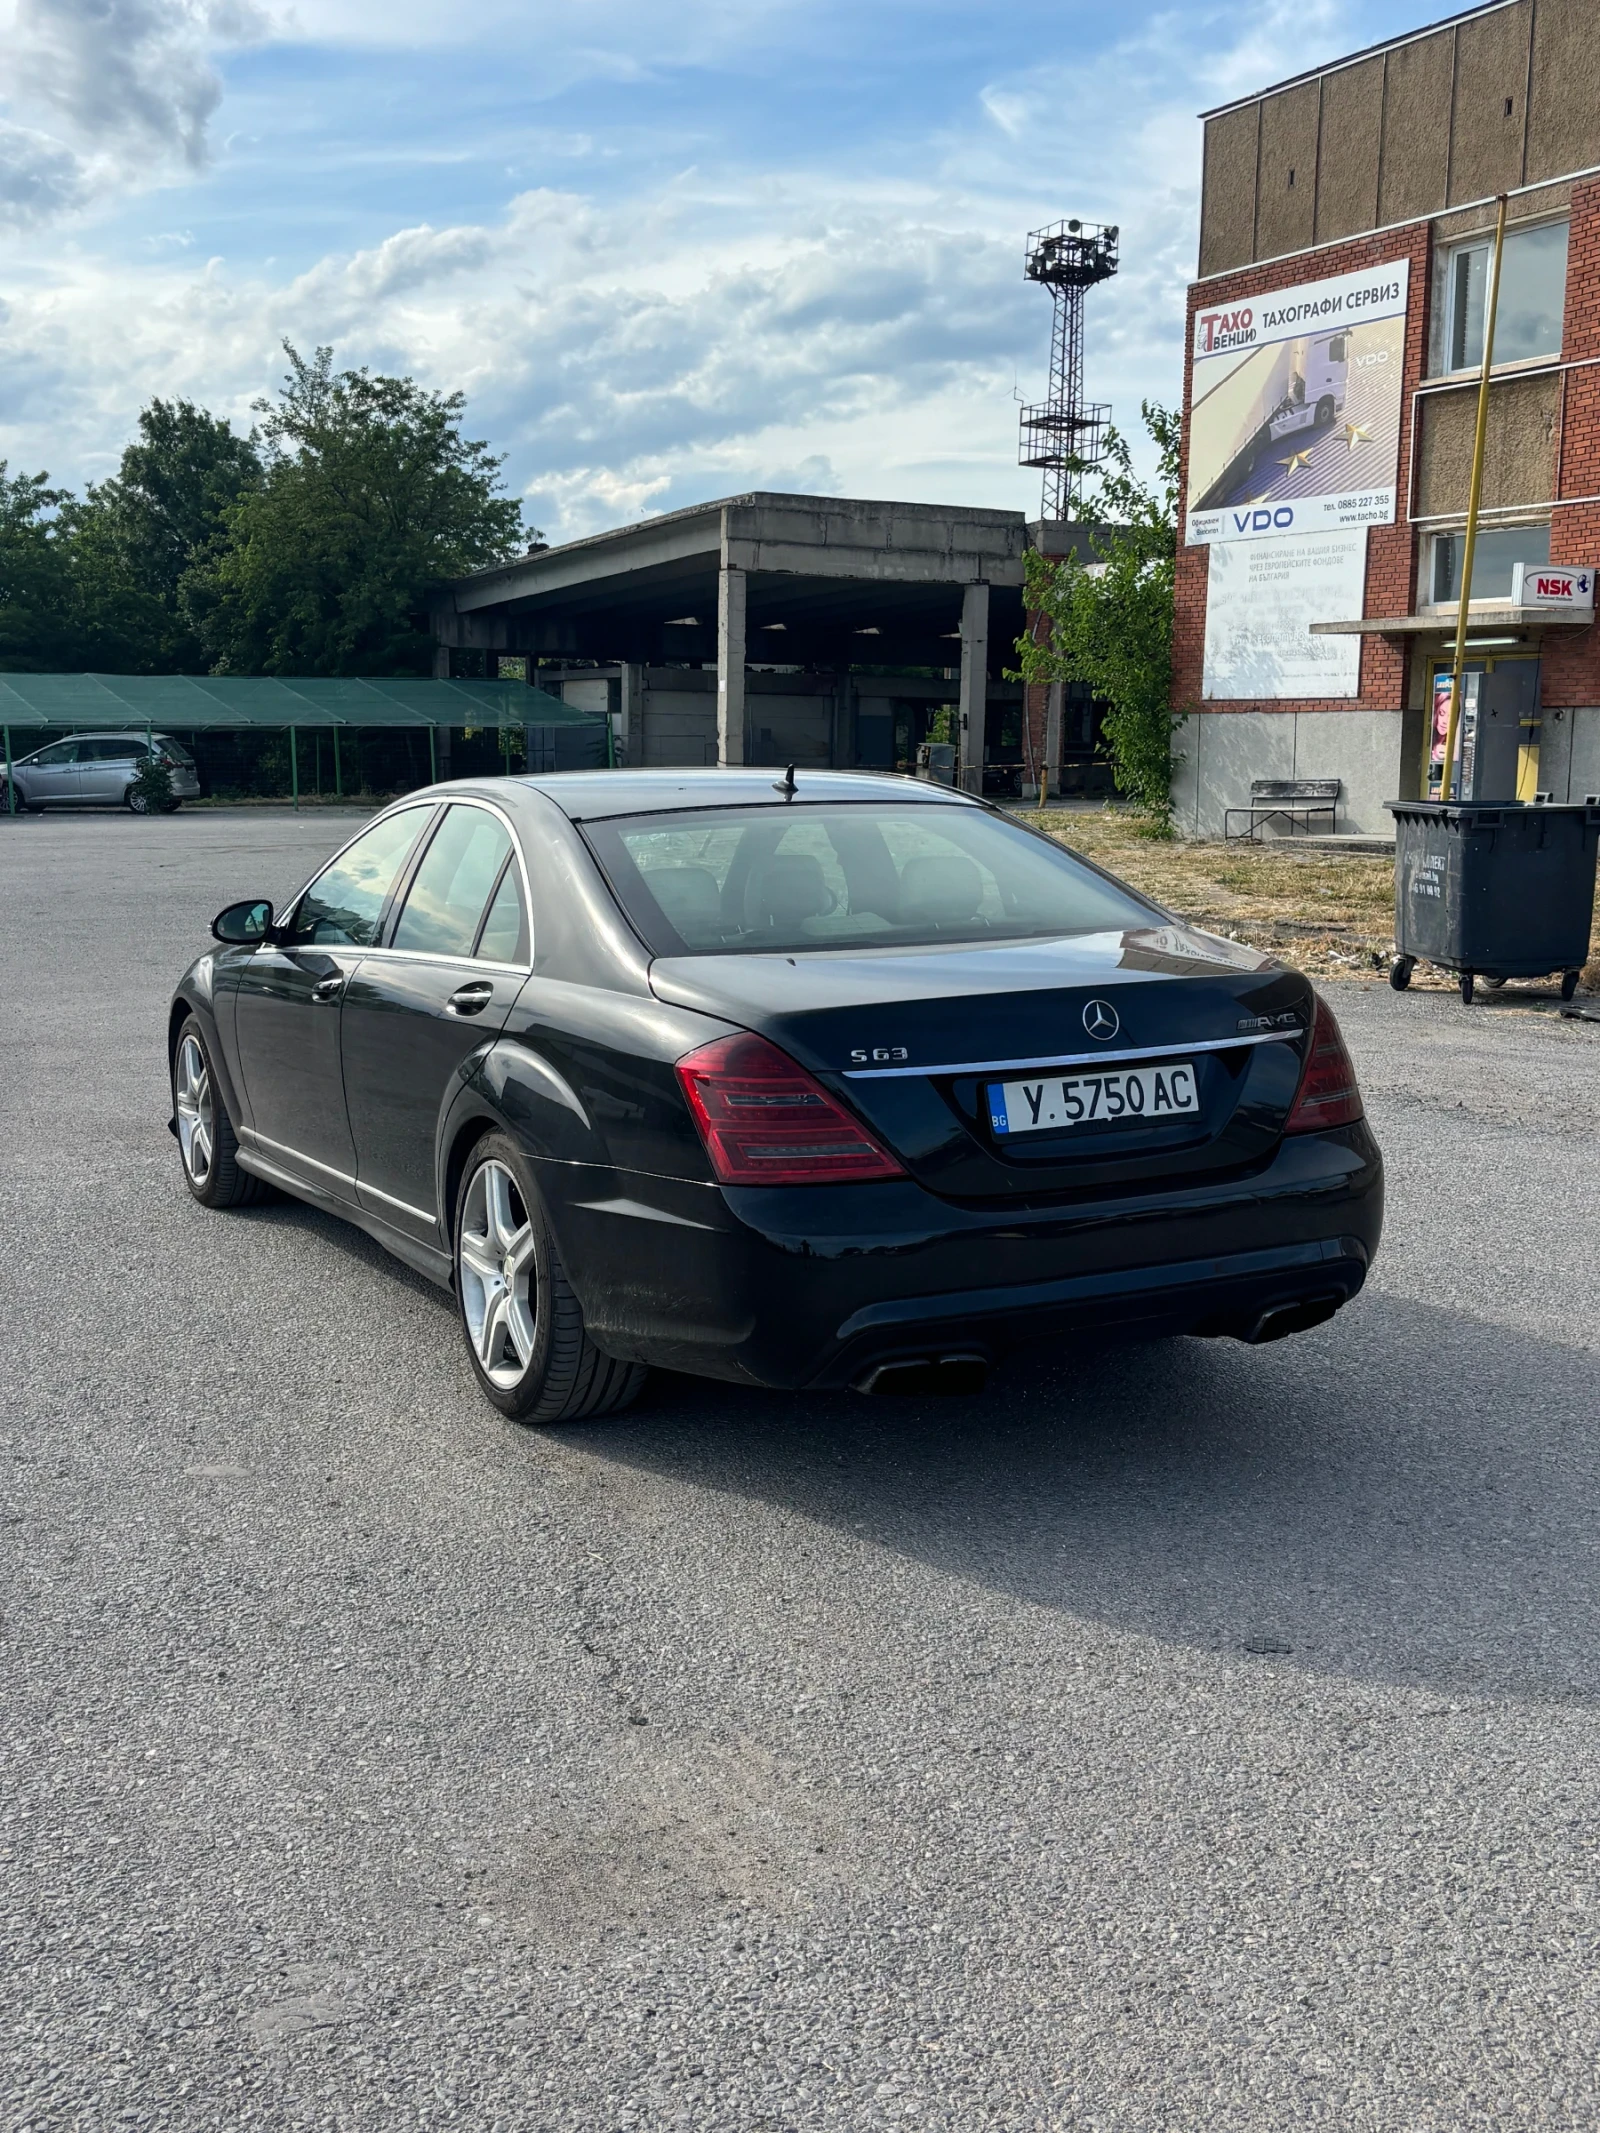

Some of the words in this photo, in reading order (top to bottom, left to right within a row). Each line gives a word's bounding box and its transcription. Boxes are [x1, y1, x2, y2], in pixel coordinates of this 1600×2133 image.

[1263, 296, 1343, 328] ТАХОГРАФИ
[1346, 282, 1400, 309] СЕРВИЗ
[1201, 308, 1253, 352] ТАХО
[1356, 351, 1388, 366] VDO
[1337, 499, 1357, 510] 0885
[1358, 497, 1373, 507] 227
[1374, 495, 1389, 505] 355
[1233, 507, 1294, 532] VDO
[1339, 510, 1389, 523] www.tacho.bg
[1296, 548, 1306, 556] НА
[1537, 578, 1573, 596] NSK
[851, 1049, 868, 1062] S
[873, 1047, 908, 1061] 63
[1062, 1075, 1145, 1120] 5750
[1154, 1070, 1192, 1111] AC
[991, 1115, 1007, 1127] BG
